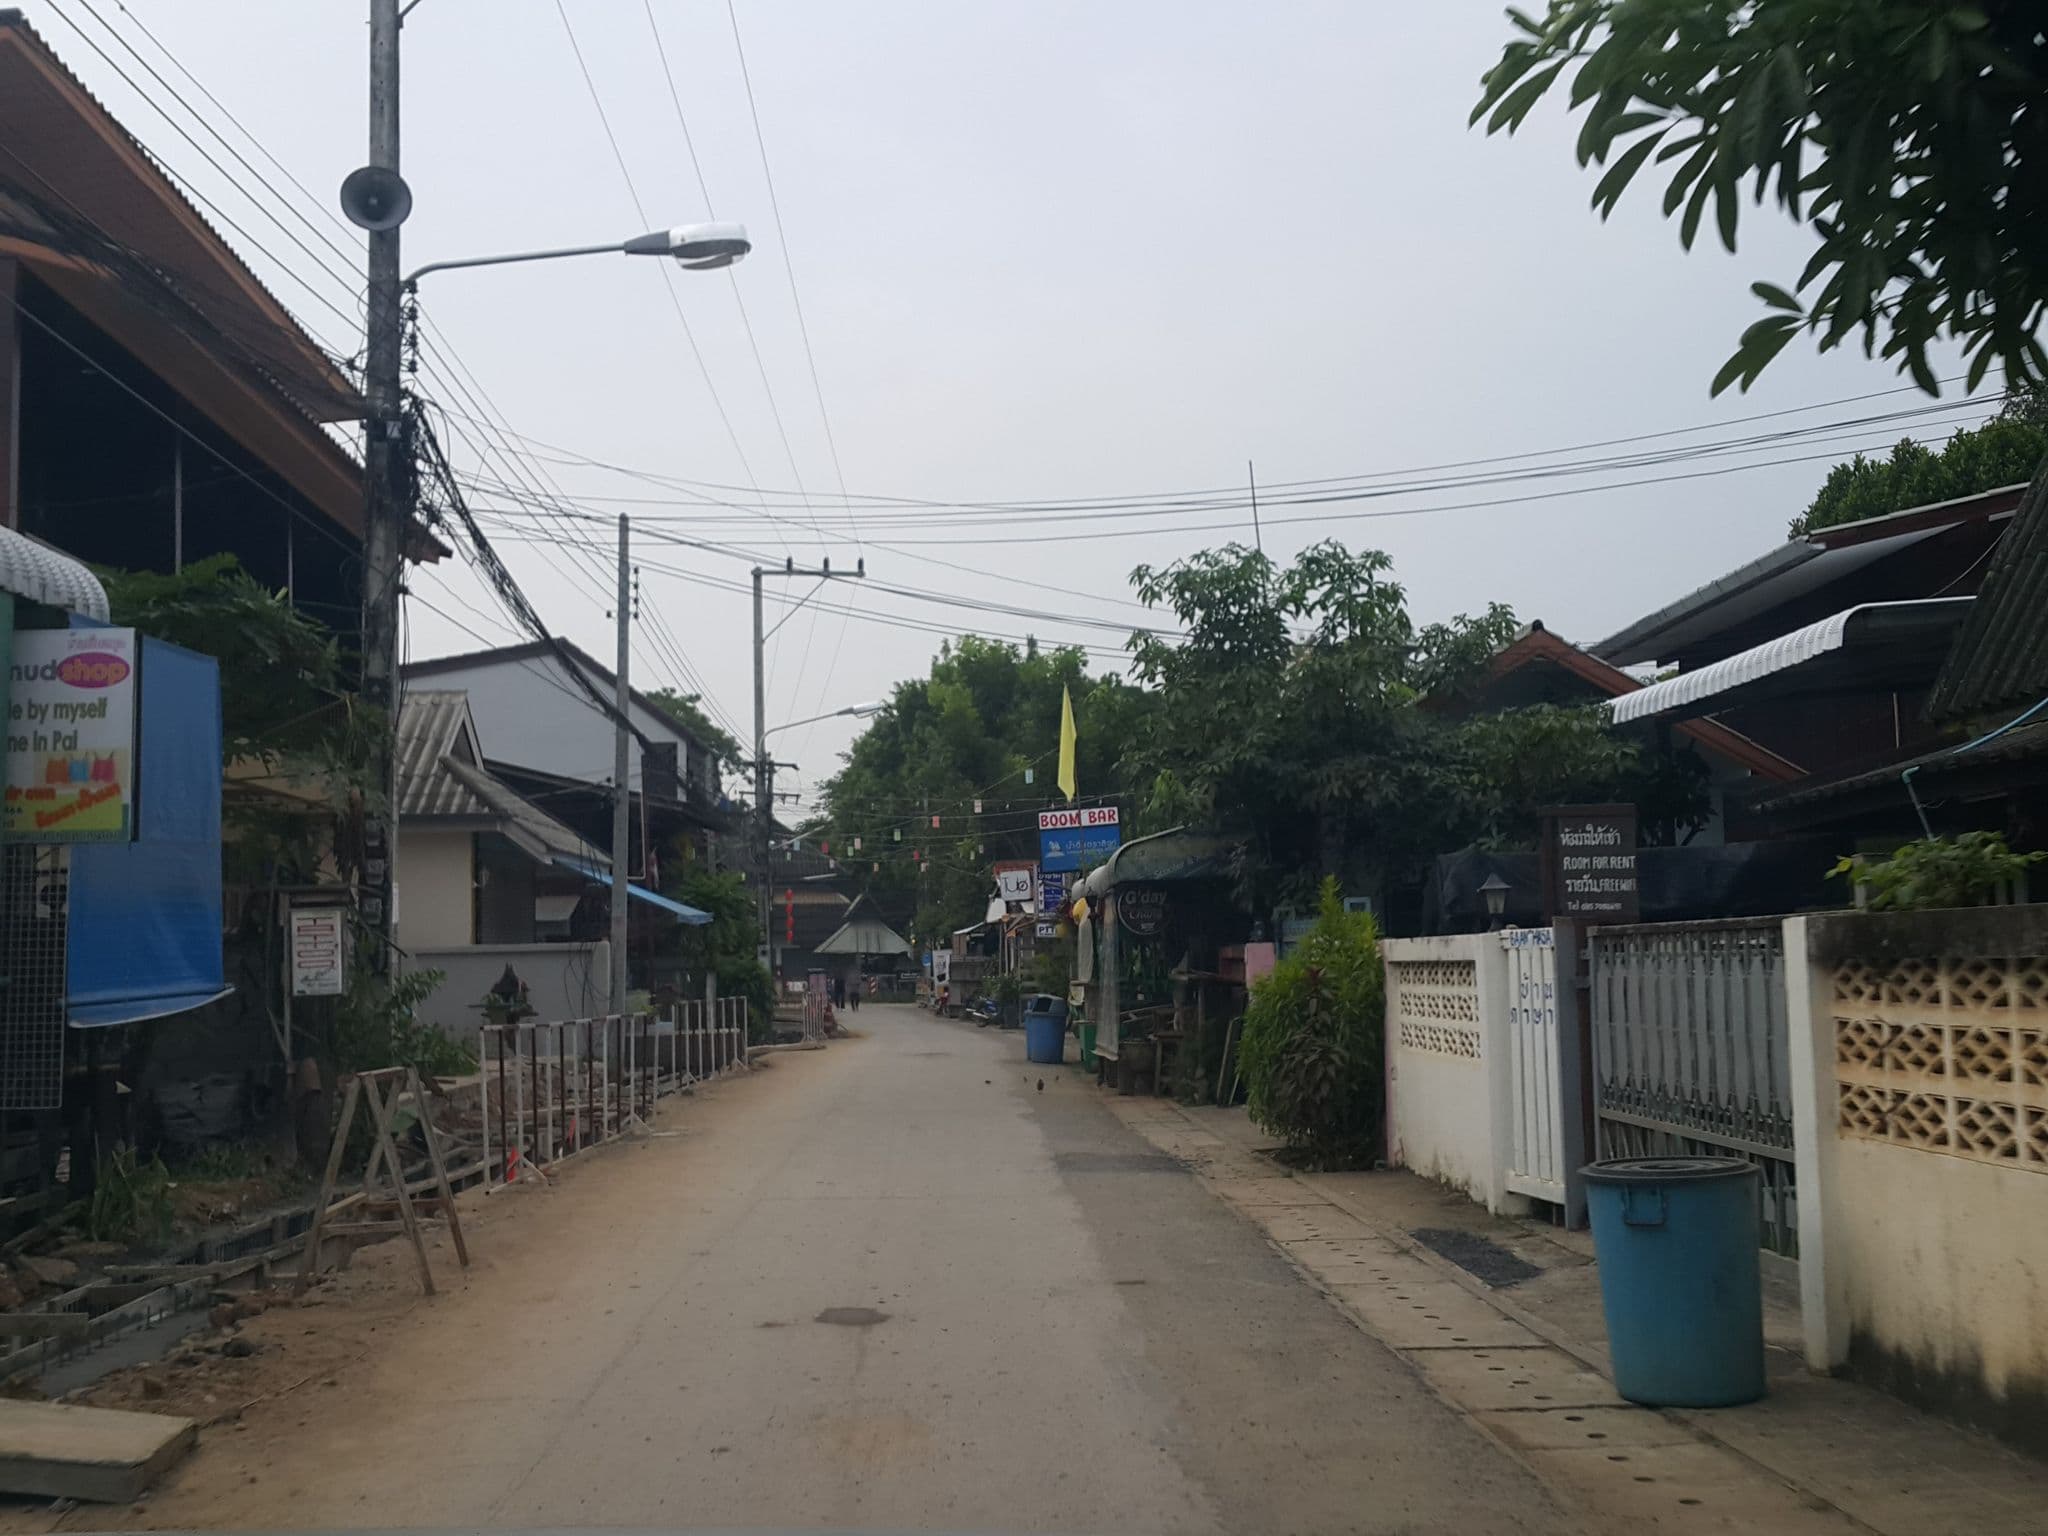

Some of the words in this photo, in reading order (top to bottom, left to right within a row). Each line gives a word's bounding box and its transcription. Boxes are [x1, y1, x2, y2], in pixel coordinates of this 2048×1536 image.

[62, 658, 126, 686] shop
[28, 699, 48, 724] by
[54, 697, 107, 724] myself
[1041, 812, 1081, 828] BOOM
[1088, 809, 1116, 824] BAR
[1563, 856, 1591, 870] ROOM
[1592, 856, 1609, 869] FOR
[1610, 855, 1636, 869] RENT
